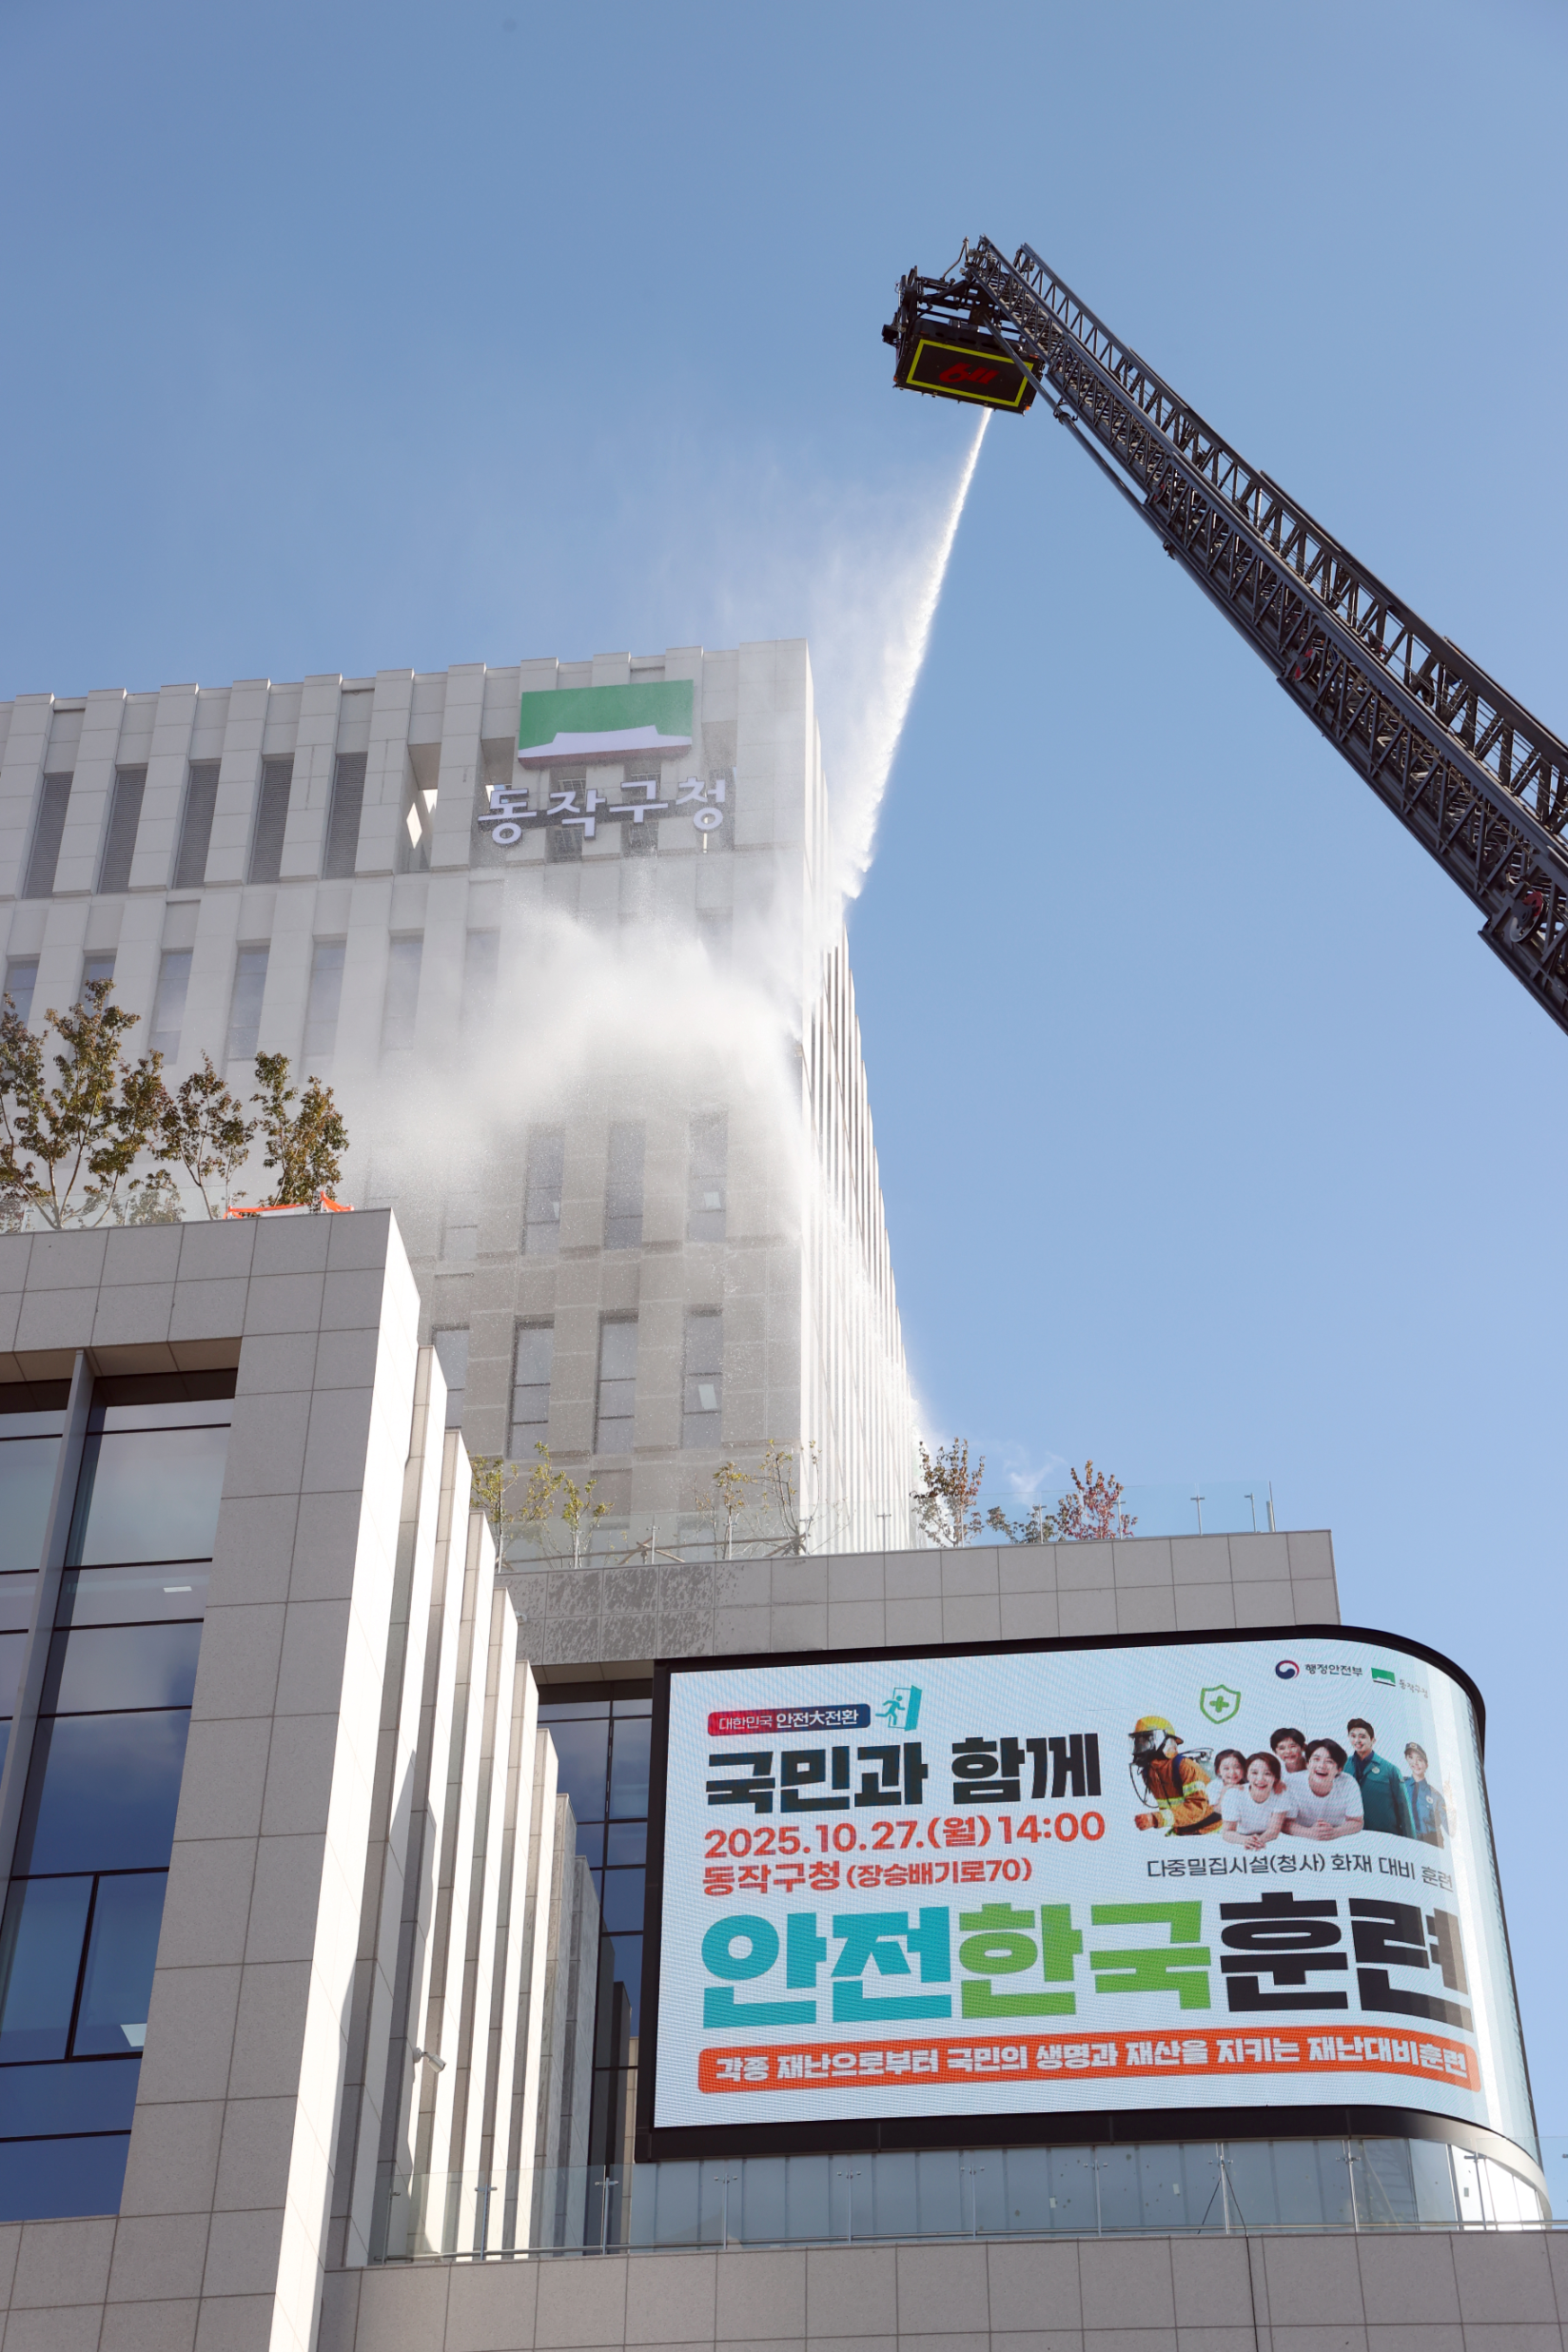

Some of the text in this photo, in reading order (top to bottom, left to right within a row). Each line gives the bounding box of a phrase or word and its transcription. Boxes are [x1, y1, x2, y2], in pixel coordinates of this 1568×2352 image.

[478, 776, 727, 847] 동작구청
[1304, 1663, 1363, 1676] 행정안전부
[718, 1709, 859, 1731] 대한민국 안전大전환
[706, 1733, 1102, 1813] 국민과 함께
[1147, 1852, 1454, 1892] 다중밀집시설(청사) 화재 대비 훈련
[715, 2036, 1468, 2082] 각종 재난으로부터 국민의 생명과 재산을 지키는 재난대비훈련
